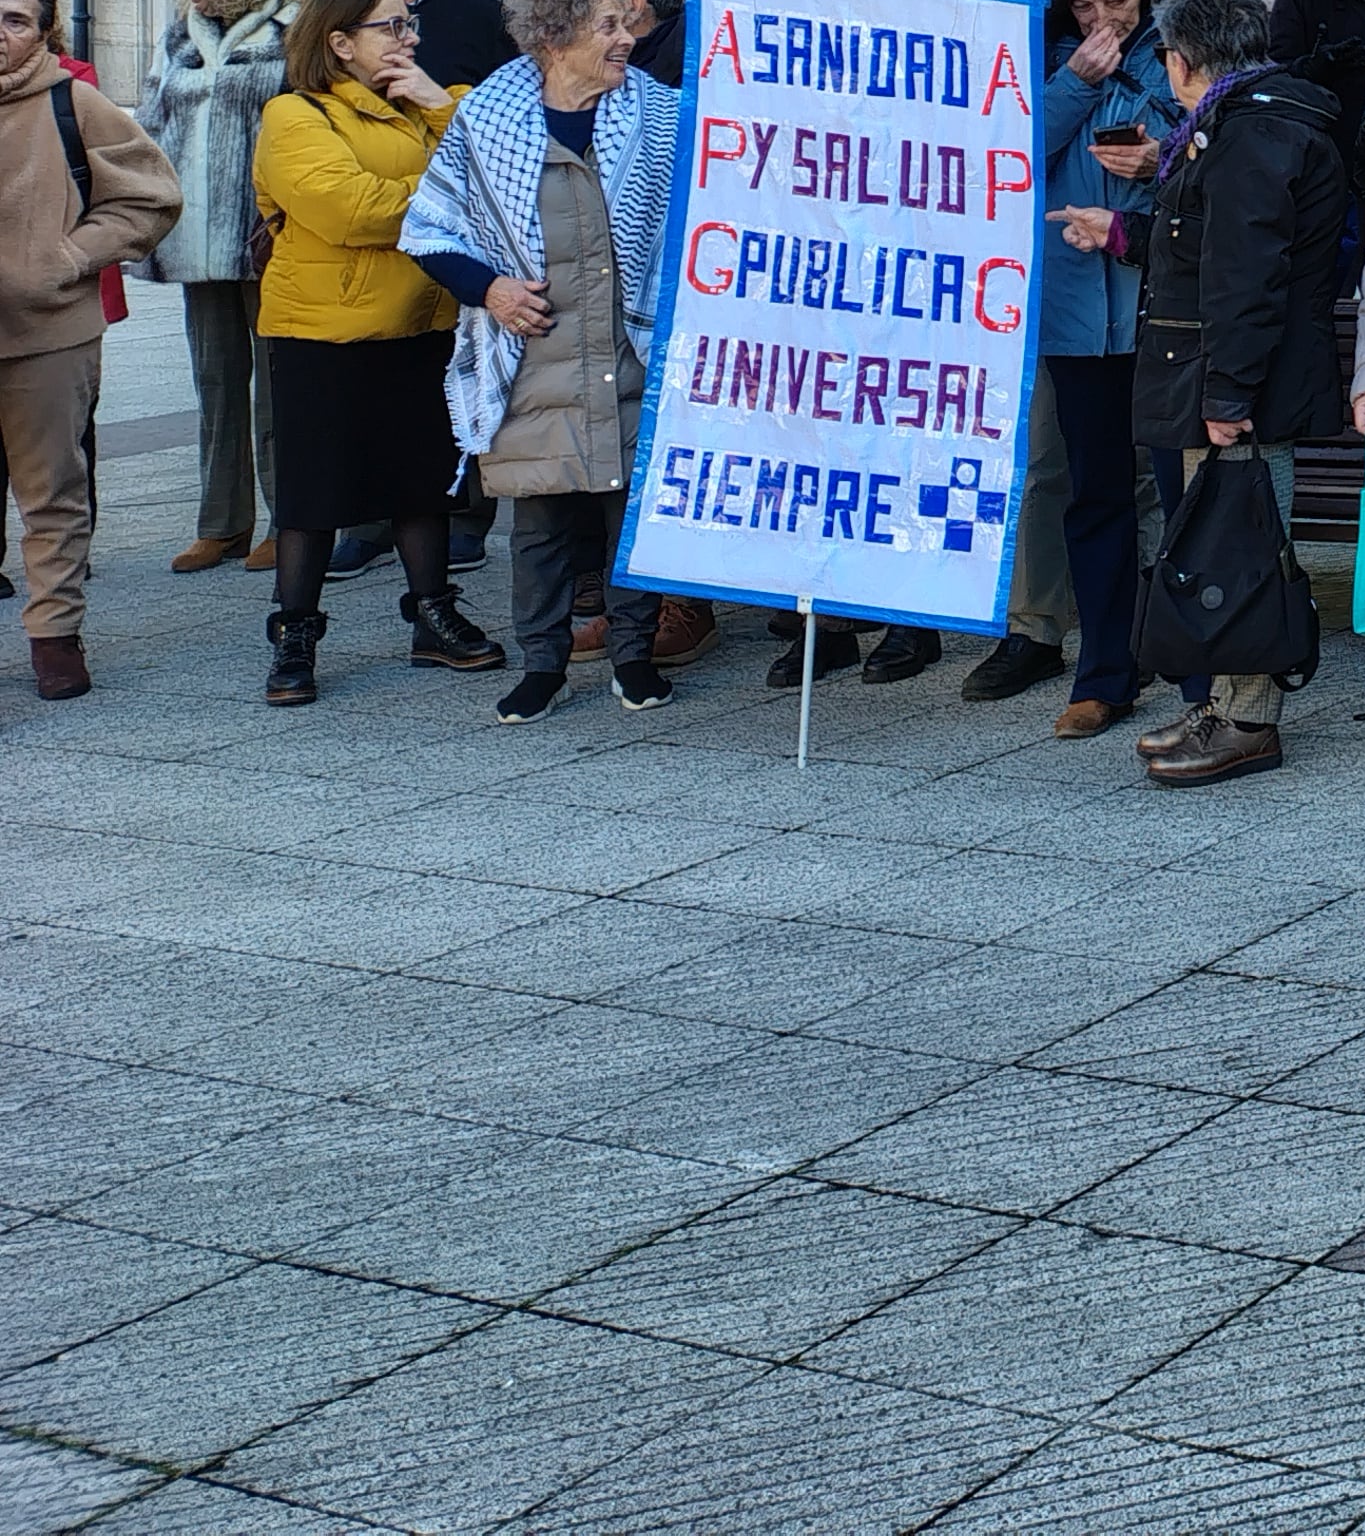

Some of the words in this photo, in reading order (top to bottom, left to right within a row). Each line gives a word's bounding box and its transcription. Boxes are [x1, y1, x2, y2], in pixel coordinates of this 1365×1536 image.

[700, 9, 745, 85] A
[752, 13, 970, 109] SANIDAD
[980, 42, 1032, 117] A
[698, 116, 747, 189] P
[748, 122, 779, 190] Y
[791, 127, 967, 216] SALUD
[985, 149, 1034, 222] P
[686, 221, 739, 296] G
[735, 230, 966, 324] PUBLICA
[974, 257, 1027, 335] G
[688, 335, 1004, 440] UNIVERSAL
[654, 445, 901, 546] SIEMPRE
